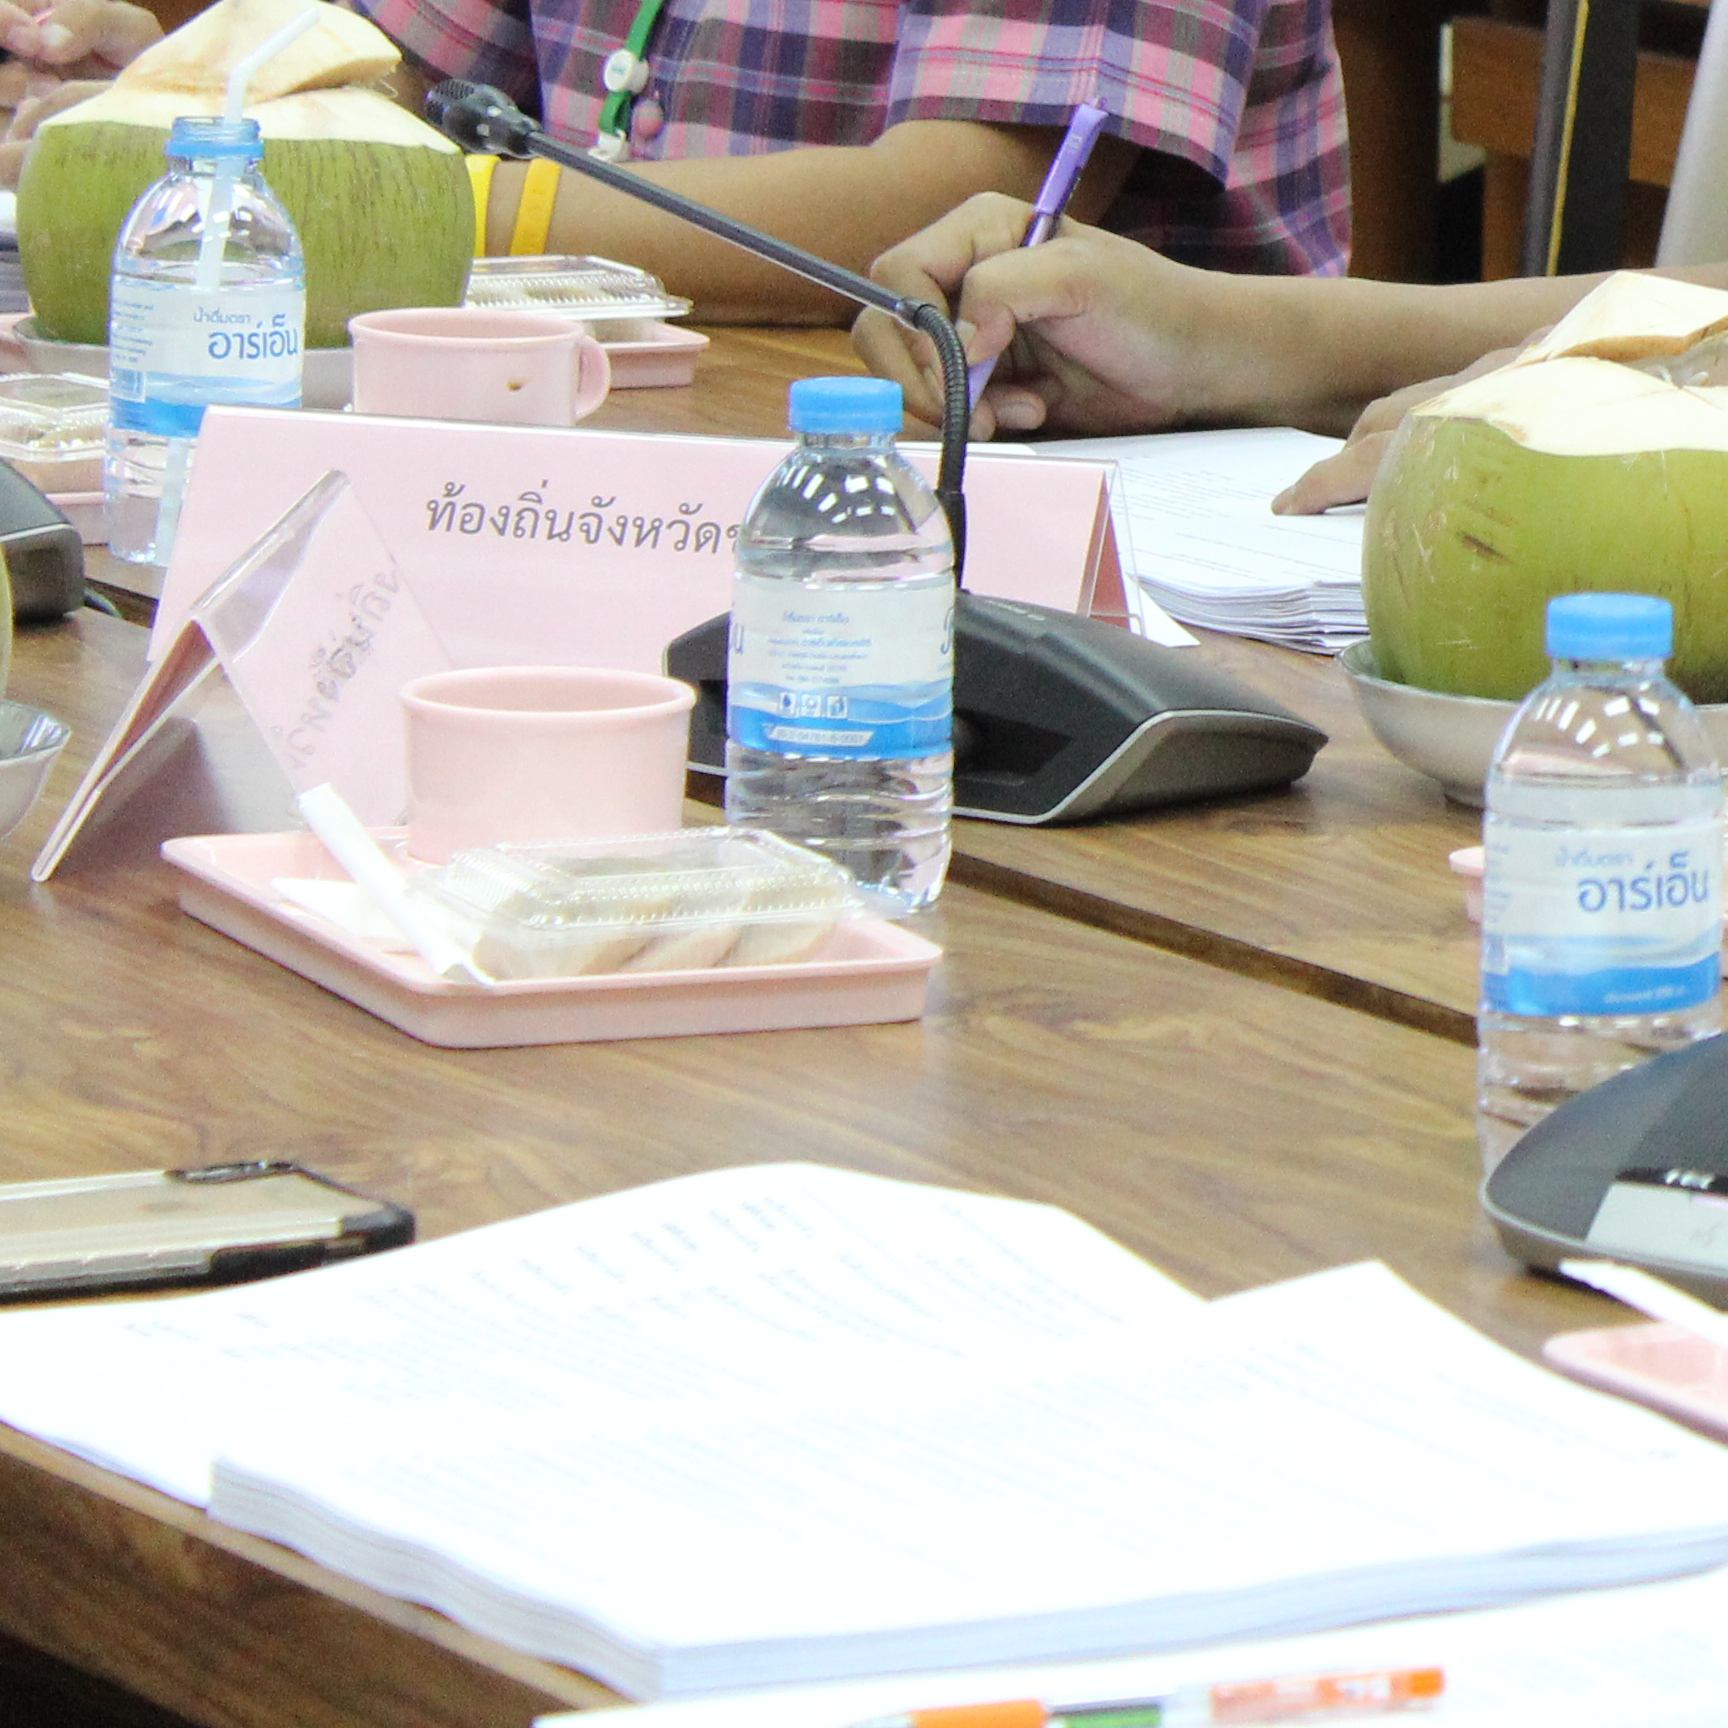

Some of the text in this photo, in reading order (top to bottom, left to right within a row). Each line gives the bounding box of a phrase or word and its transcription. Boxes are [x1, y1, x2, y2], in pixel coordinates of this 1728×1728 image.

[207, 313, 299, 360] อาร์เอ็น
[1577, 850, 1711, 915] อาร์เอ็น
